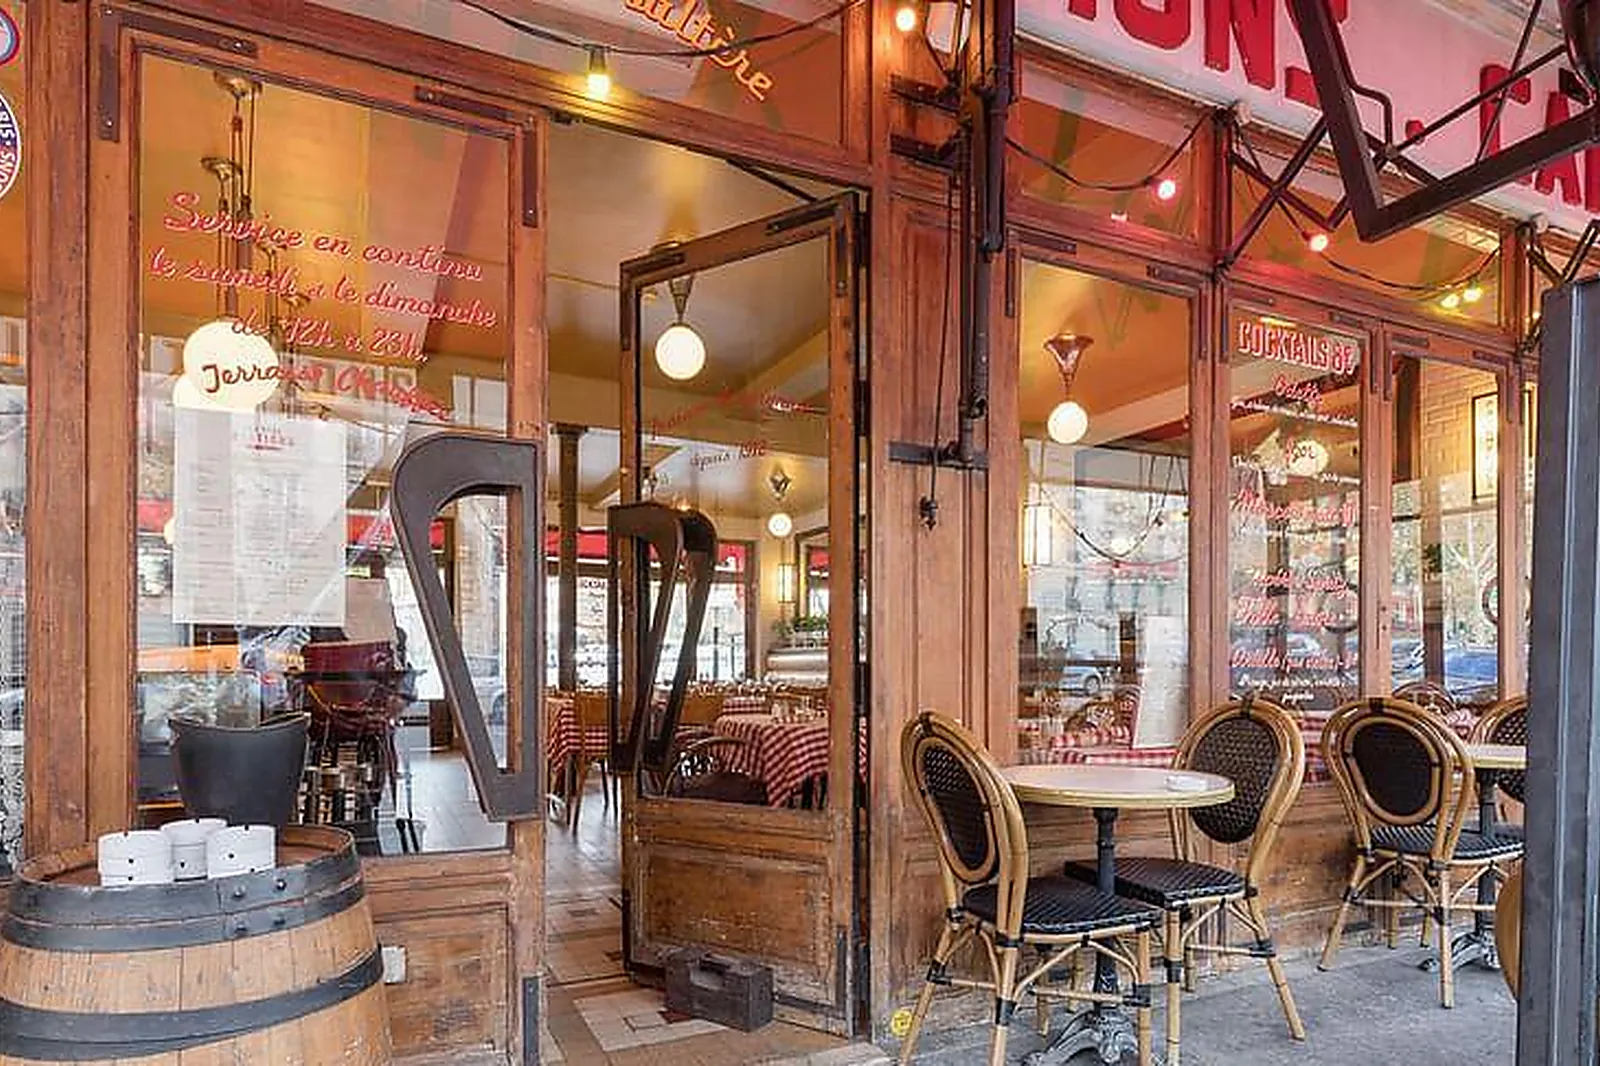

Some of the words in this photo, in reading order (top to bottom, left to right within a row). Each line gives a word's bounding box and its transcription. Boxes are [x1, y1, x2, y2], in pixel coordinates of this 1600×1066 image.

[164, 191, 304, 247] Service
[313, 235, 351, 258] en
[362, 245, 484, 282] continu
[150, 247, 177, 278] le
[185, 261, 299, 295] samedi
[334, 272, 359, 304] le
[364, 281, 498, 328] dimanche
[1238, 320, 1331, 372] COCKTAILS
